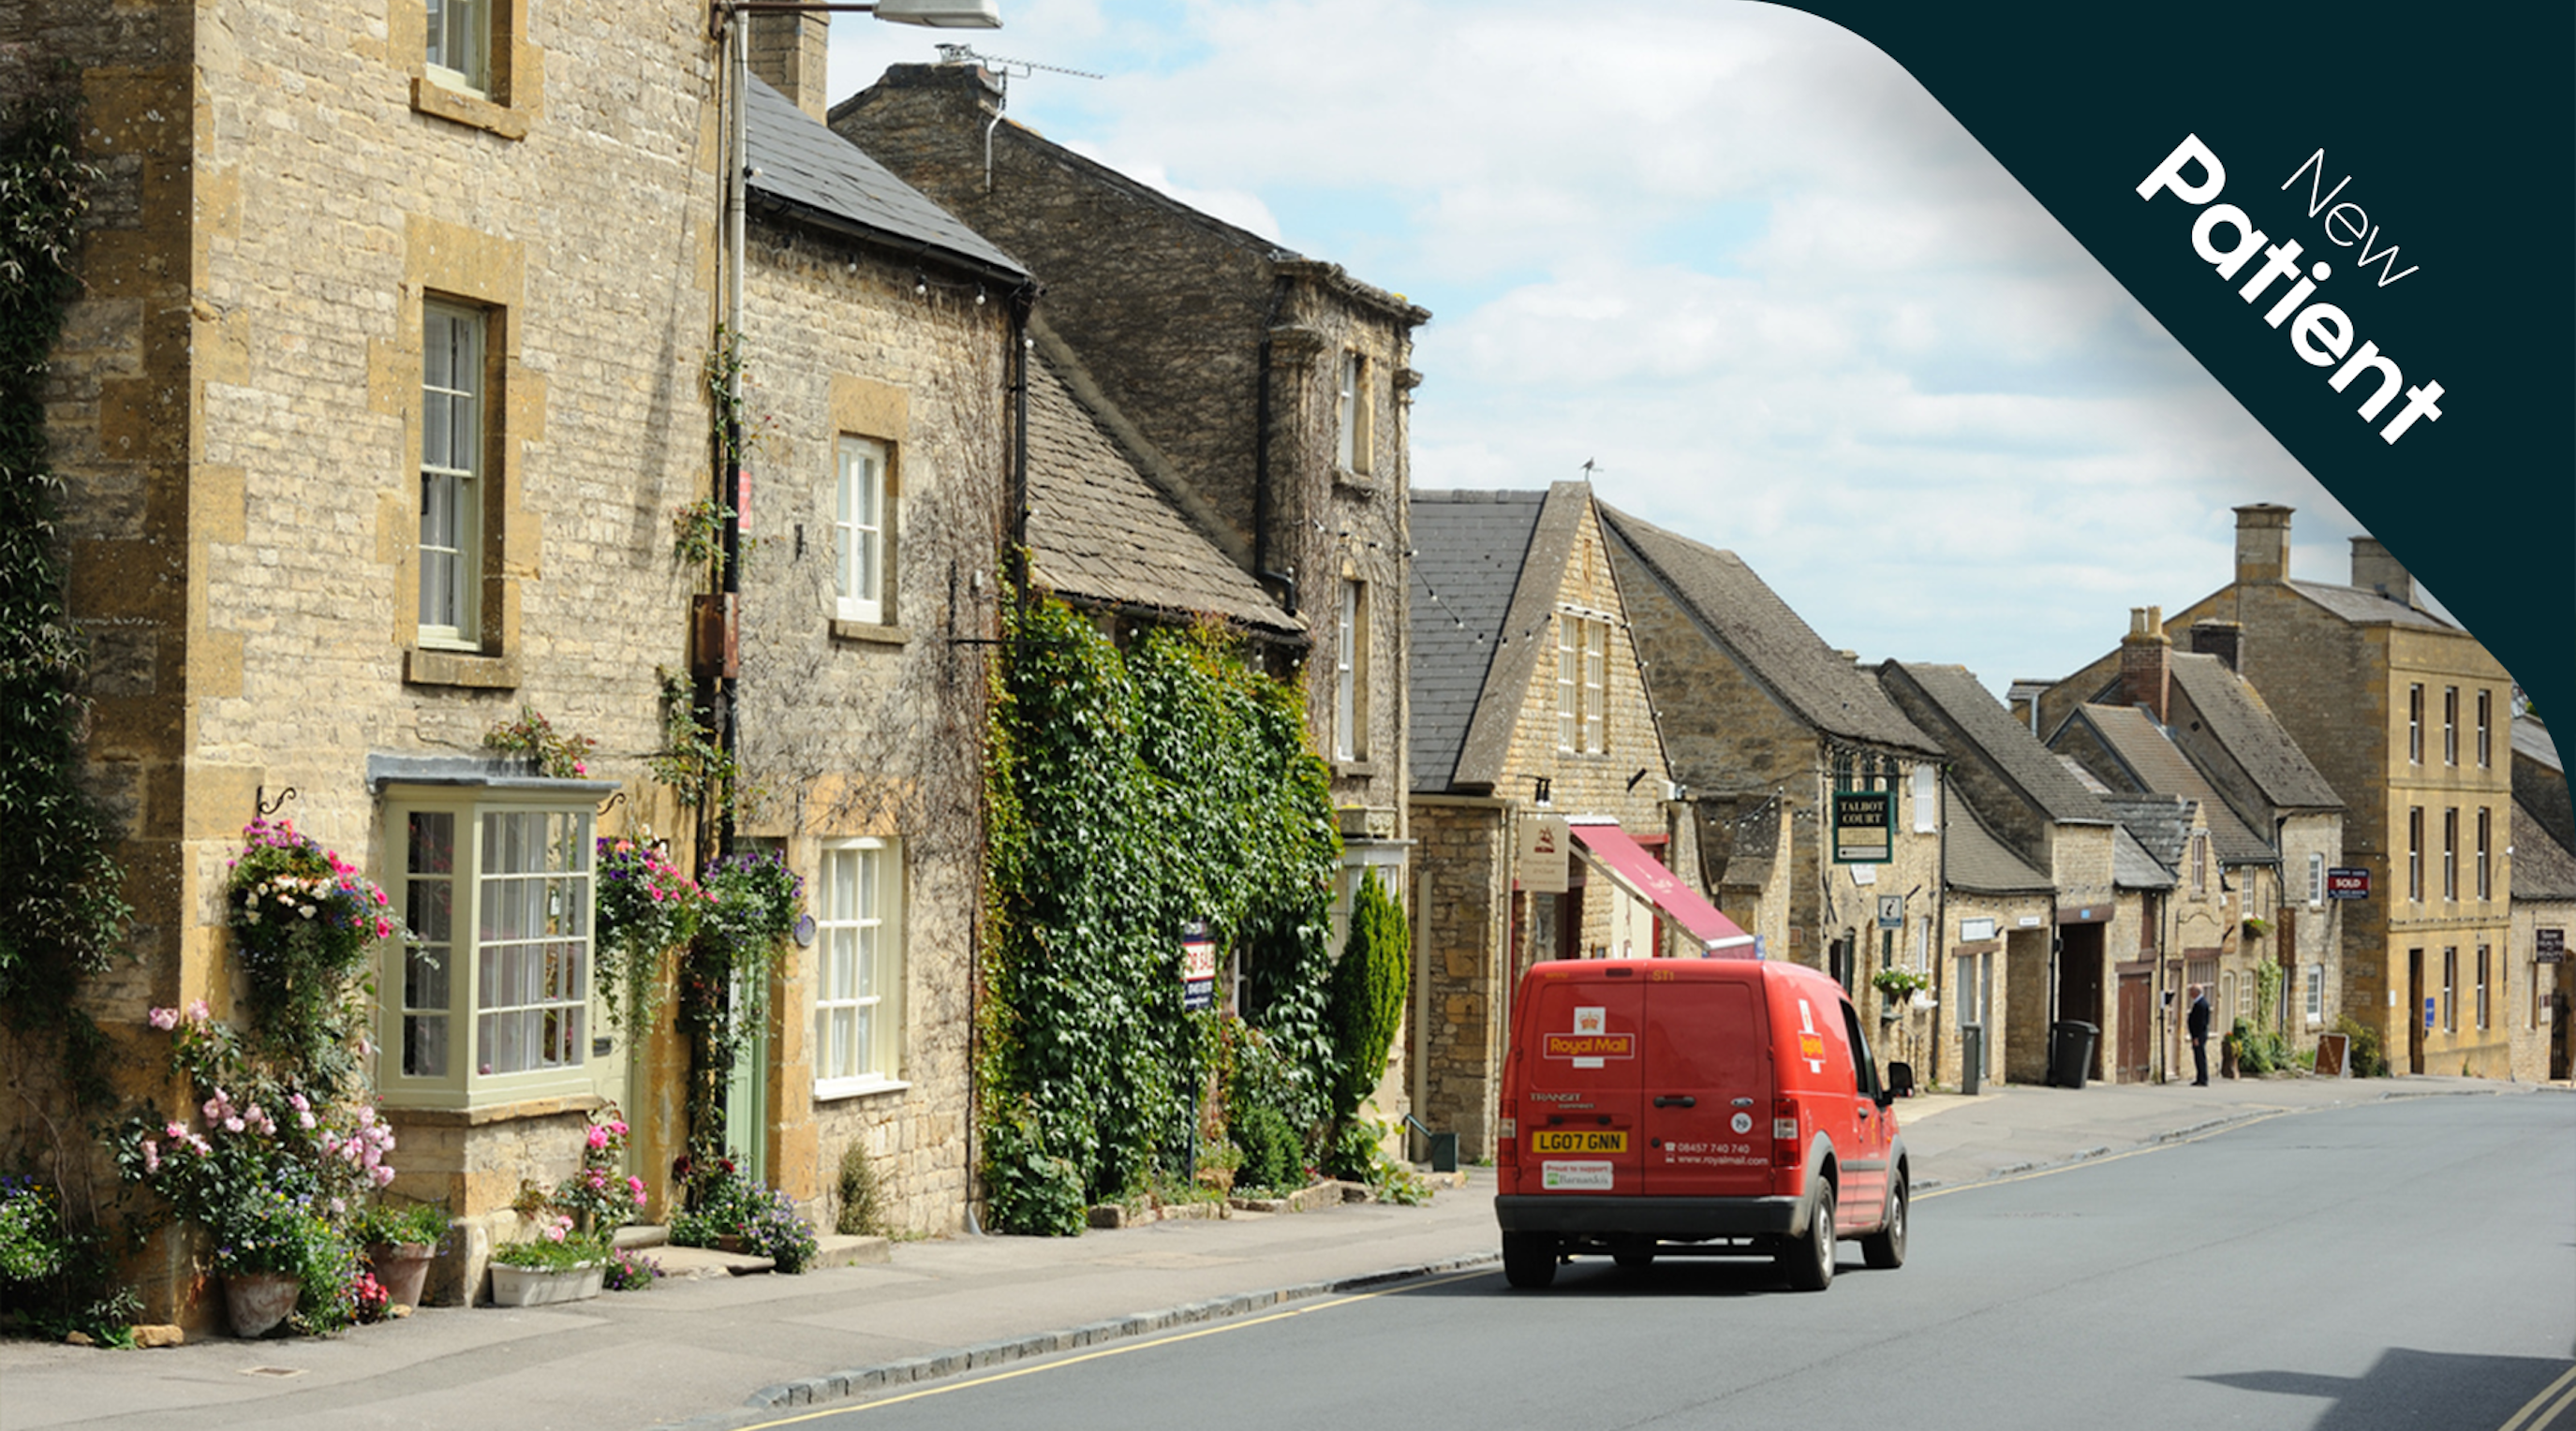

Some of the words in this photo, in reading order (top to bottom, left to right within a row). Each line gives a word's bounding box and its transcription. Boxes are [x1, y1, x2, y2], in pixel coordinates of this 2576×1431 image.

[1839, 801, 1885, 812] TALBOT
[1842, 814, 1883, 824] COURT
[2335, 878, 2361, 889] SOLD
[1550, 1037, 1592, 1055] Royal
[1594, 1038, 1628, 1052] Mail
[1530, 1092, 1581, 1101] TRANSIT
[1540, 1133, 1583, 1150] LG07
[1588, 1133, 1621, 1150] GNN
[1677, 1143, 1708, 1153] 08457
[1710, 1143, 1729, 1153] 740
[1731, 1143, 1750, 1154] 740
[1677, 1155, 1769, 1166] www.royalmail.com
[1547, 1164, 1568, 1173] Proud
